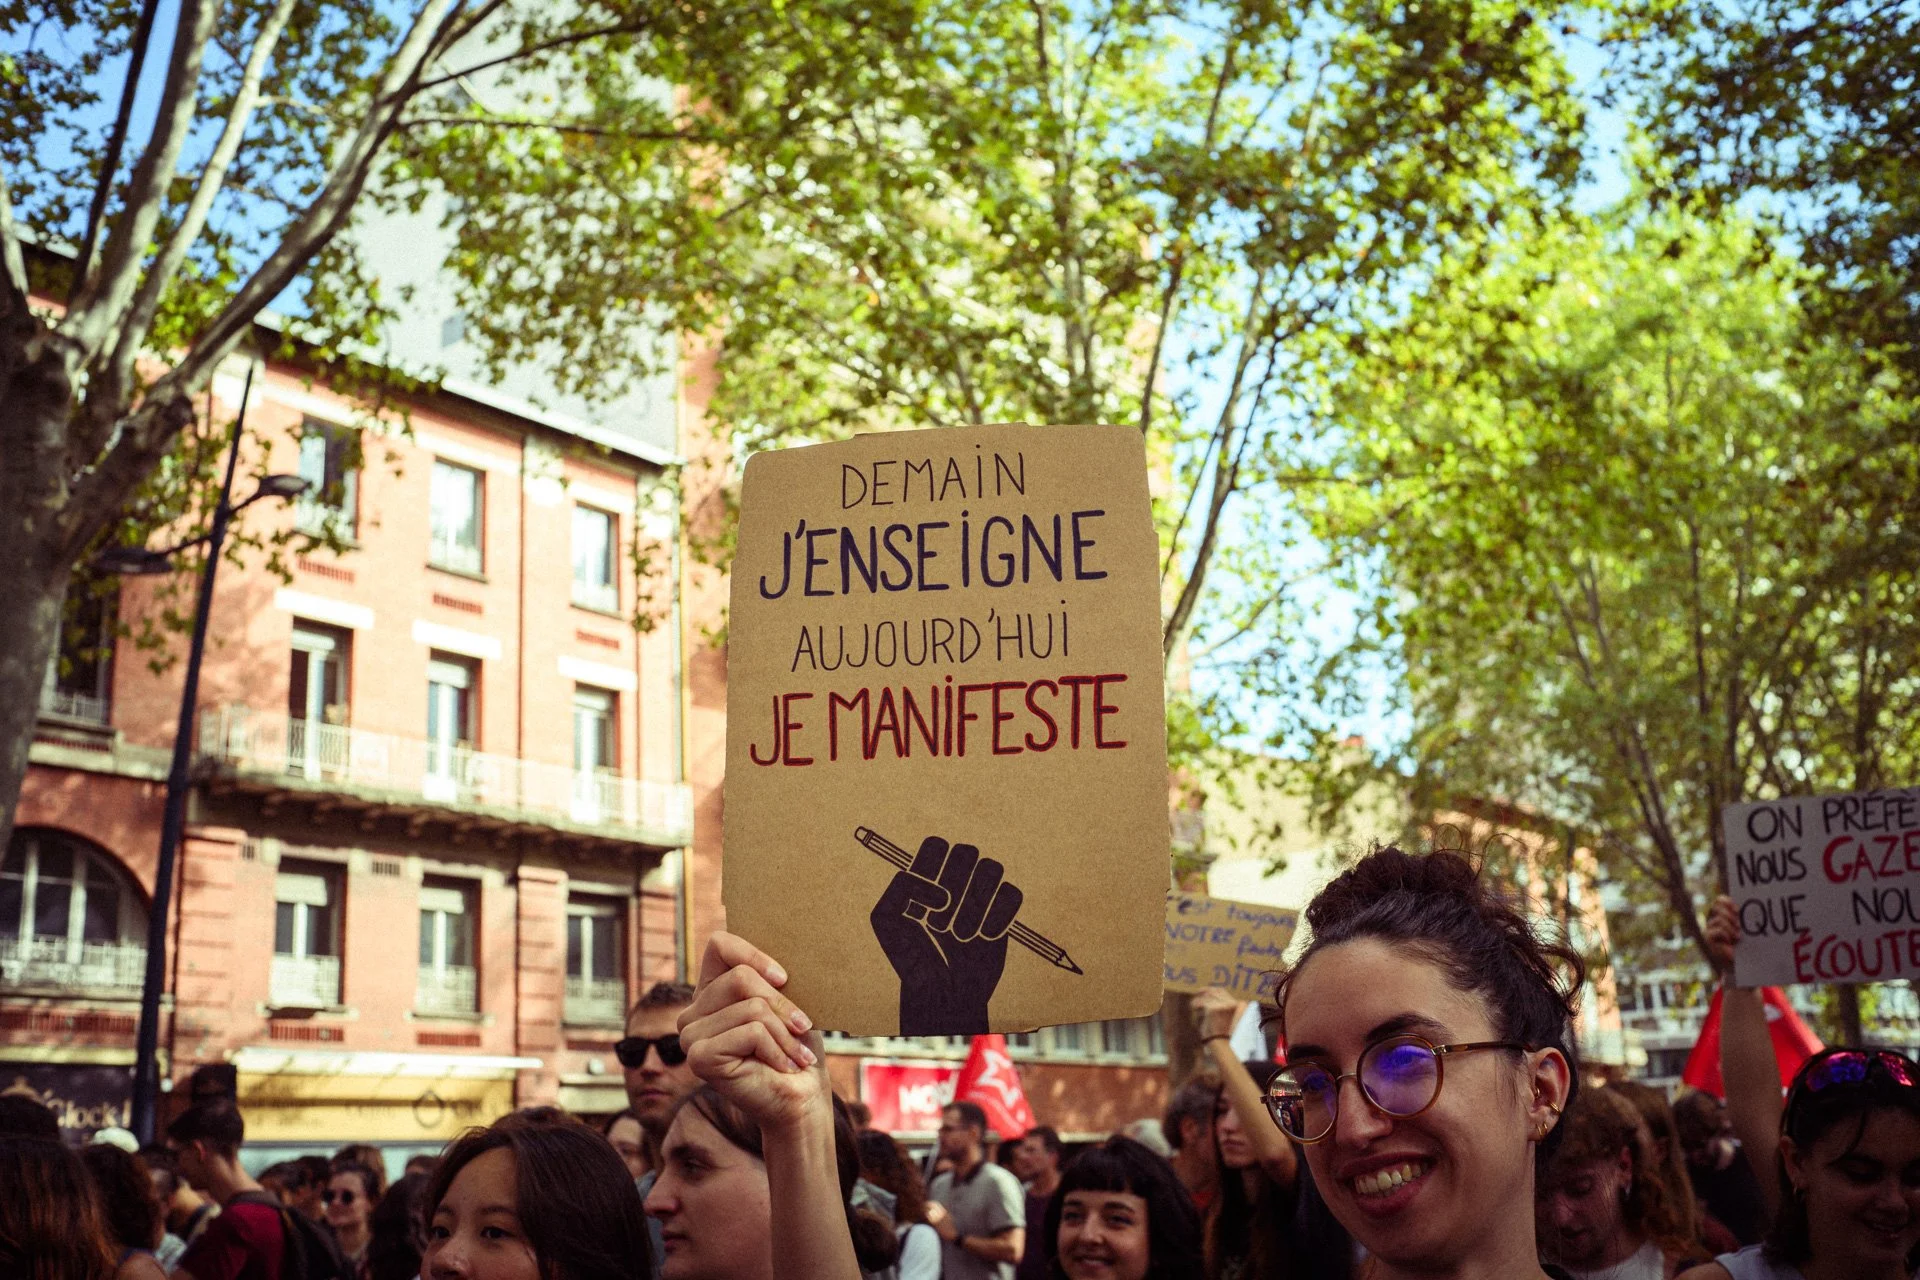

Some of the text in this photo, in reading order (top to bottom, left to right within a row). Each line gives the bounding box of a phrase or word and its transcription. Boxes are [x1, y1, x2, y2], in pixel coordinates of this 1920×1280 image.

[749, 691, 815, 767] JE
[1746, 805, 1804, 844] ON
[1735, 830, 1920, 888] NOUS GAZE
[1738, 893, 1809, 937] QUE
